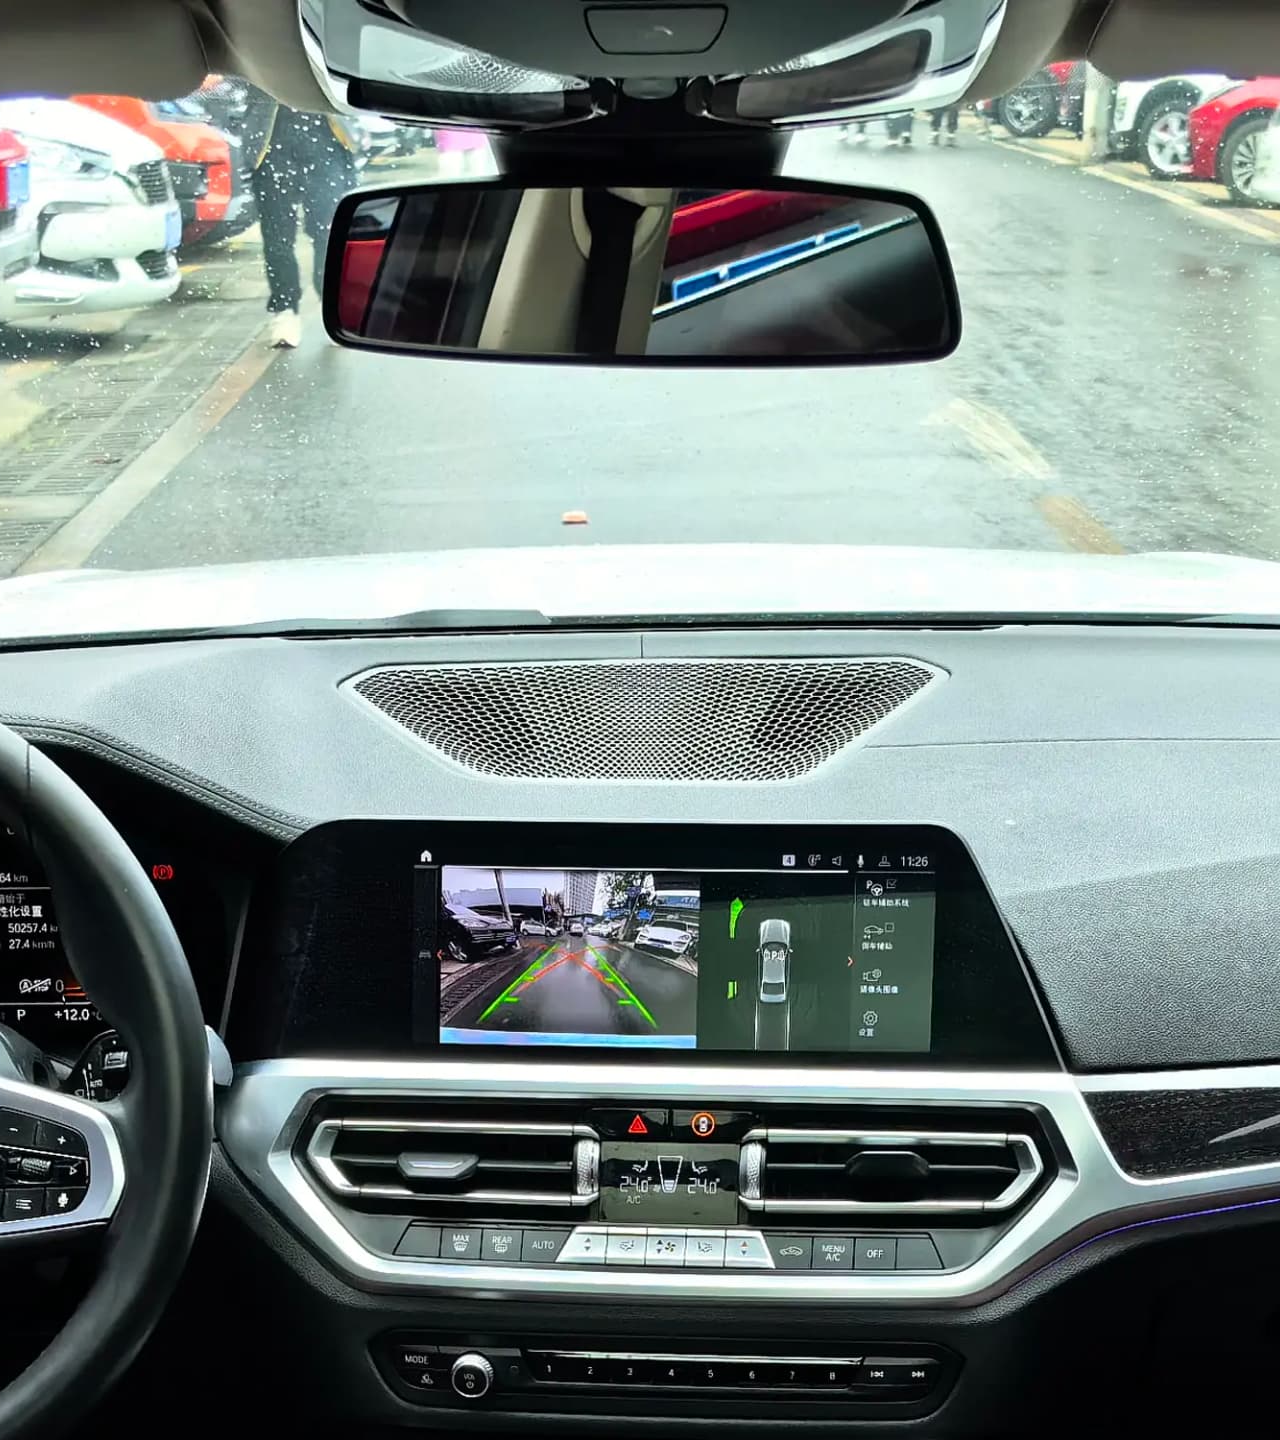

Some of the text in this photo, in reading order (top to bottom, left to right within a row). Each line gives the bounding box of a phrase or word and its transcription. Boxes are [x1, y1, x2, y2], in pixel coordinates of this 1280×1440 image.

[900, 856, 928, 867] 11:26
[13, 874, 29, 883] km
[7, 923, 48, 934] 50257.4
[8, 939, 30, 950] 27.4
[55, 979, 64, 993] 0
[17, 1009, 26, 1021] P
[452, 1234, 470, 1242] MAX
[492, 1235, 513, 1244] REAR
[531, 1240, 555, 1250] AUTO
[822, 1244, 846, 1253] MENU
[825, 1253, 841, 1262] A/C
[866, 1249, 884, 1258] OFF
[405, 1354, 429, 1365] MODE
